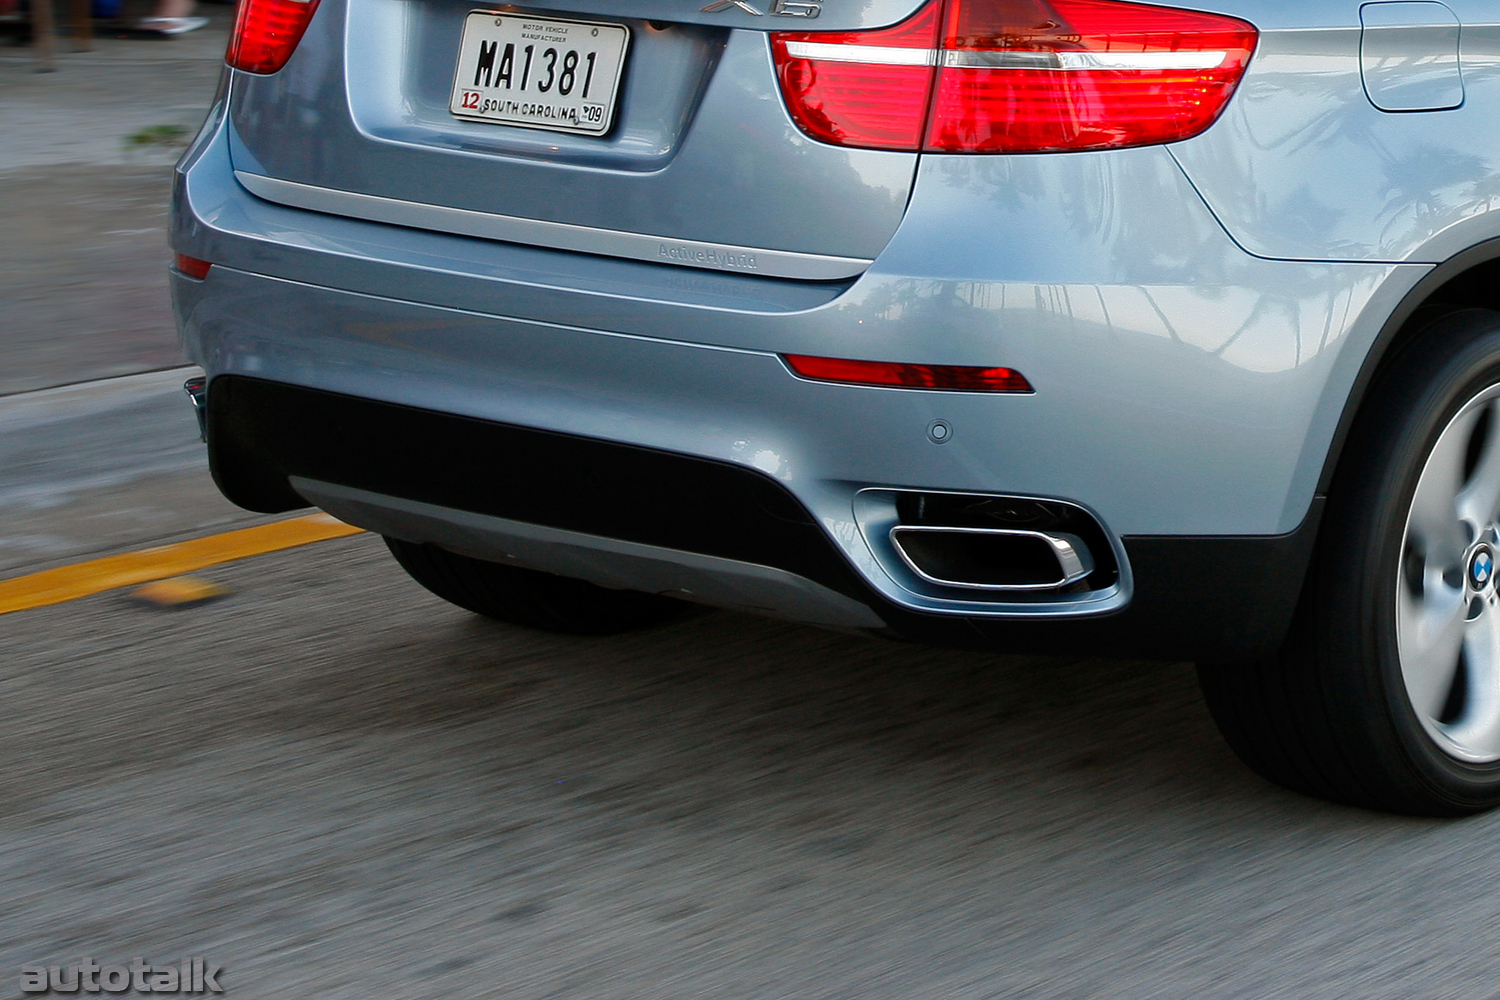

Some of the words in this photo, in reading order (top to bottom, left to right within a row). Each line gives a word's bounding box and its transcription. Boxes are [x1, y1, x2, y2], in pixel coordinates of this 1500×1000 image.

[521, 32, 567, 43] MANUFACTURER
[522, 23, 543, 31] MOTOR
[545, 26, 569, 34] VEHICLE
[474, 39, 597, 99] MA1381
[461, 91, 480, 110] 12
[484, 98, 519, 115] SOUTH
[521, 103, 576, 120] CAROLINA
[588, 105, 603, 122] 09
[657, 243, 758, 269] ActiveHybrid
